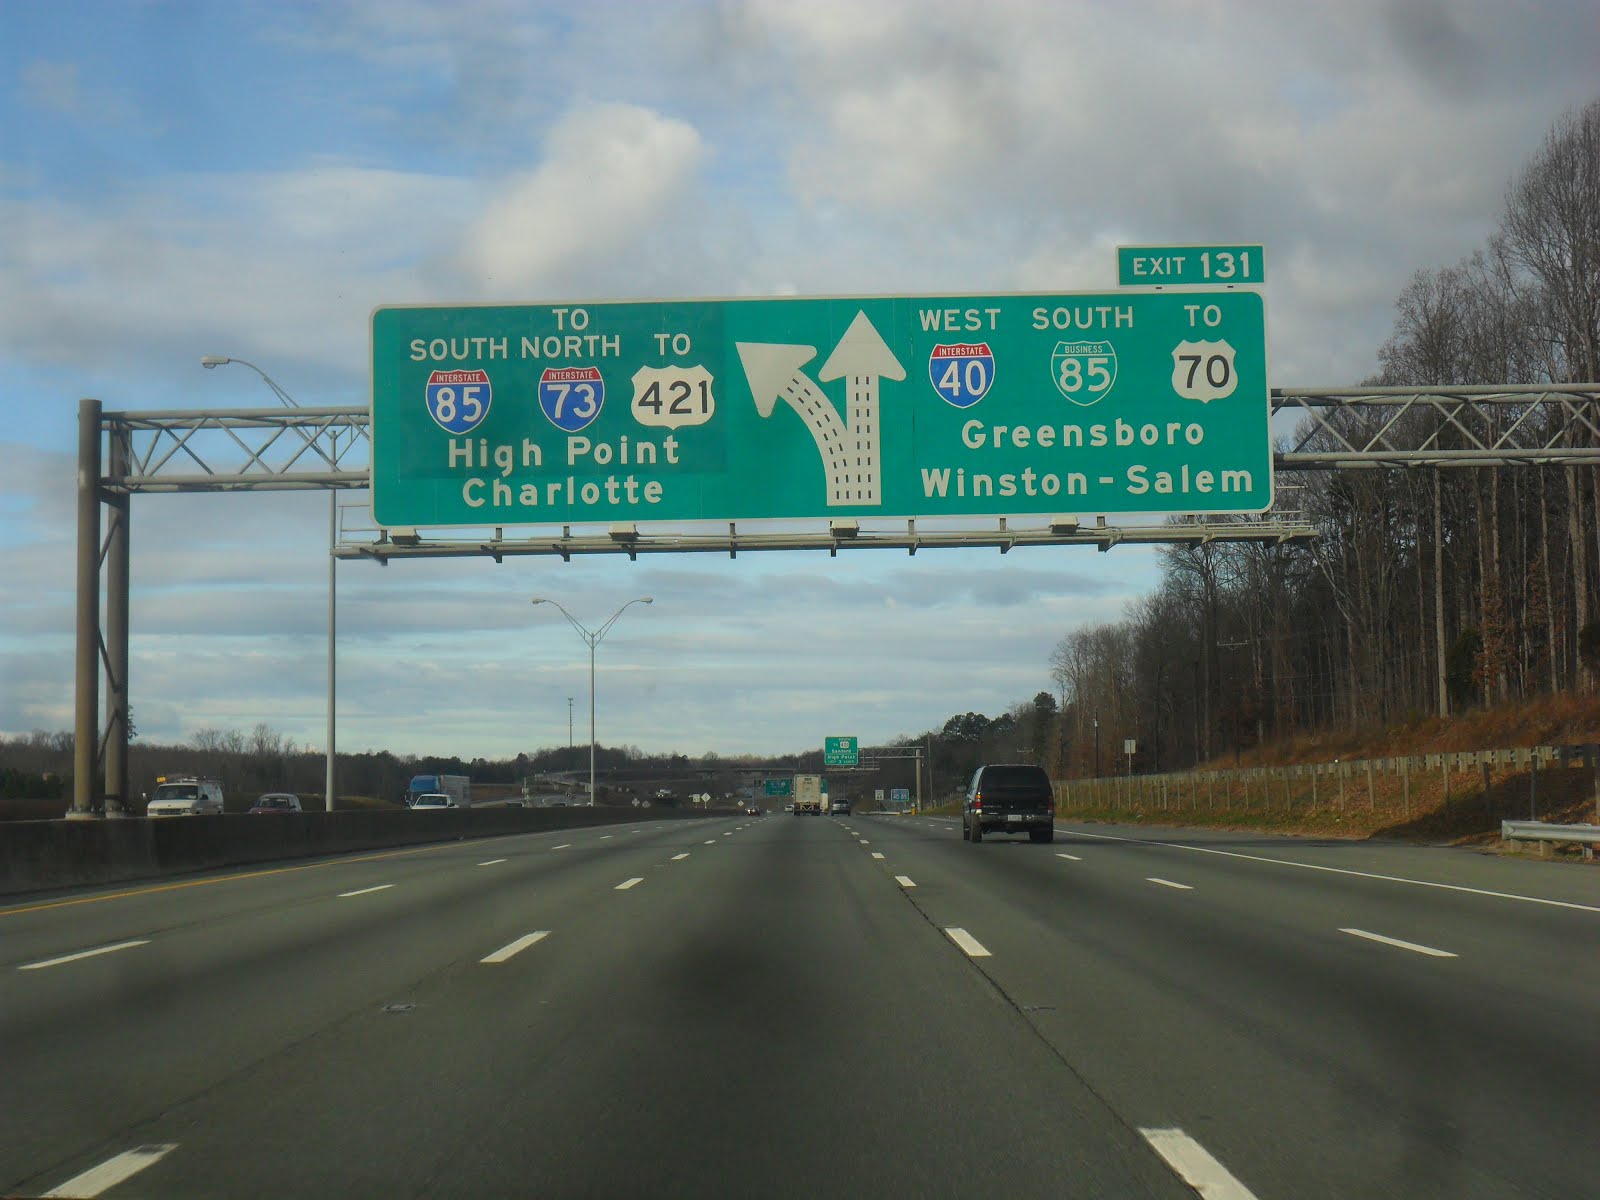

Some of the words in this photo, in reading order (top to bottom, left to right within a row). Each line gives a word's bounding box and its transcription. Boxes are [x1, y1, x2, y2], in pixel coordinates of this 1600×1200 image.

[1134, 257, 1185, 274] EXIT
[1201, 252, 1249, 277] 131
[553, 309, 588, 330] TO
[920, 309, 1000, 331] WEST
[1033, 307, 1132, 329] SOUTH
[1184, 305, 1221, 326] TO
[411, 338, 507, 360] SOUTH
[522, 335, 619, 358] NORTH
[654, 334, 690, 355] TO
[939, 347, 983, 356] INTERSTATE
[437, 374, 481, 382] INTERSTATE
[549, 371, 593, 380] INTERSTATE
[939, 360, 986, 396] 40
[1060, 358, 1110, 392] 85
[1179, 354, 1230, 388] 70
[436, 387, 482, 423] 85
[547, 384, 596, 419] 73
[638, 380, 708, 414] 421
[962, 418, 1203, 448] Greensboro
[449, 439, 541, 477] High
[568, 435, 678, 465] Point
[463, 475, 662, 507] Charlotte
